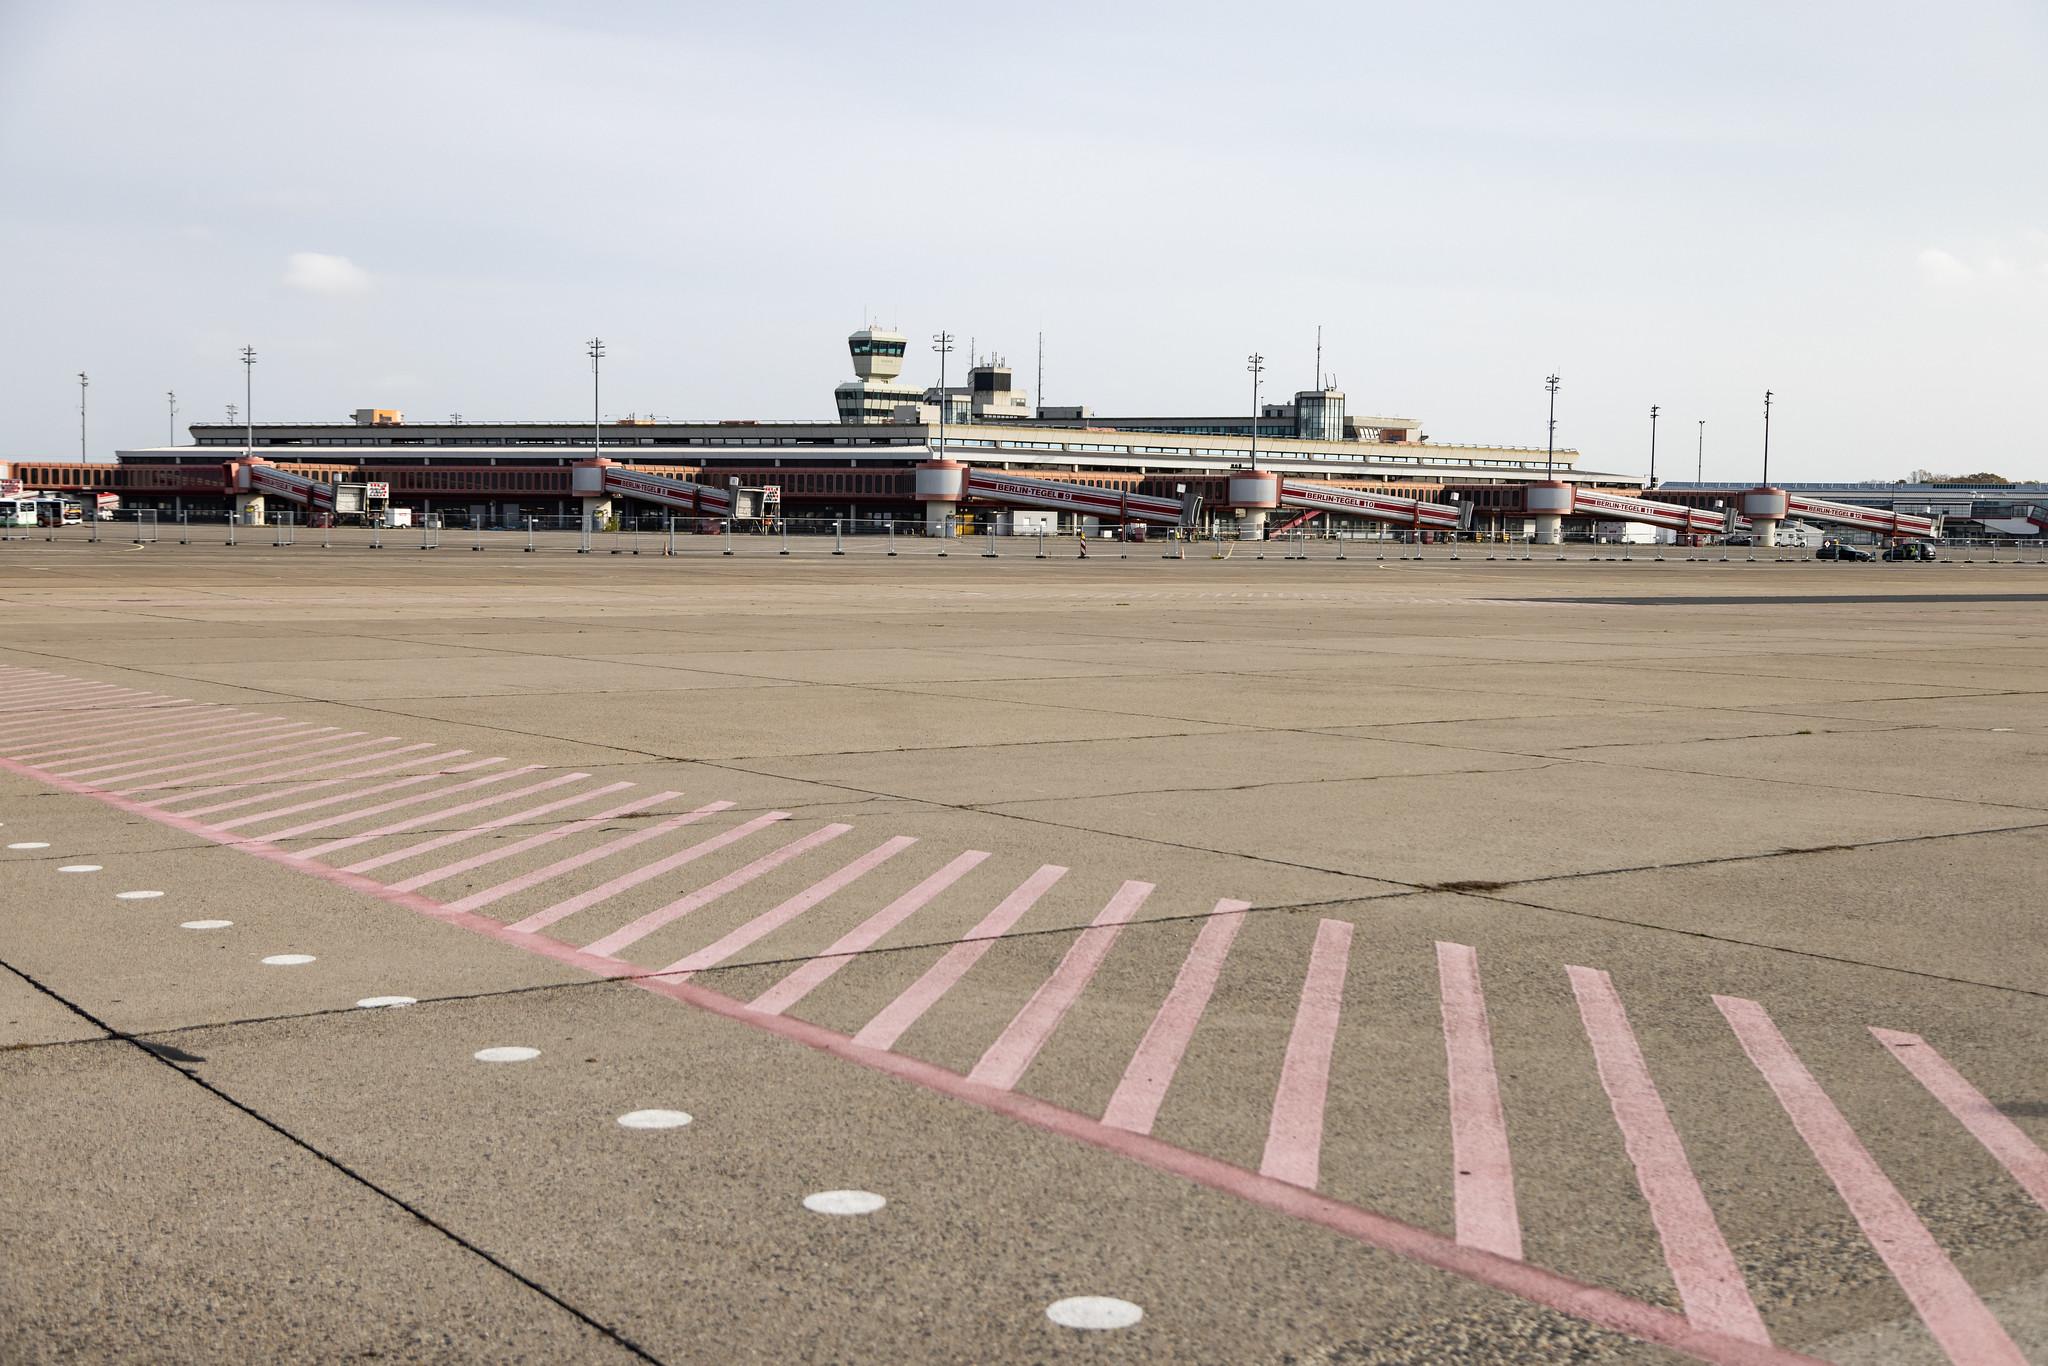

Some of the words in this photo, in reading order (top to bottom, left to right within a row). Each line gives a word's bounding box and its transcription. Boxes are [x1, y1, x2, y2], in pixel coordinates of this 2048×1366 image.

[997, 484, 1057, 498] BERLIN-TEGEL
[1306, 493, 1359, 506] BERLIN-TEGEL
[1596, 500, 1640, 512] BERLIN-TEGEL
[1808, 505, 1849, 517] BERLIN-TEGEL
